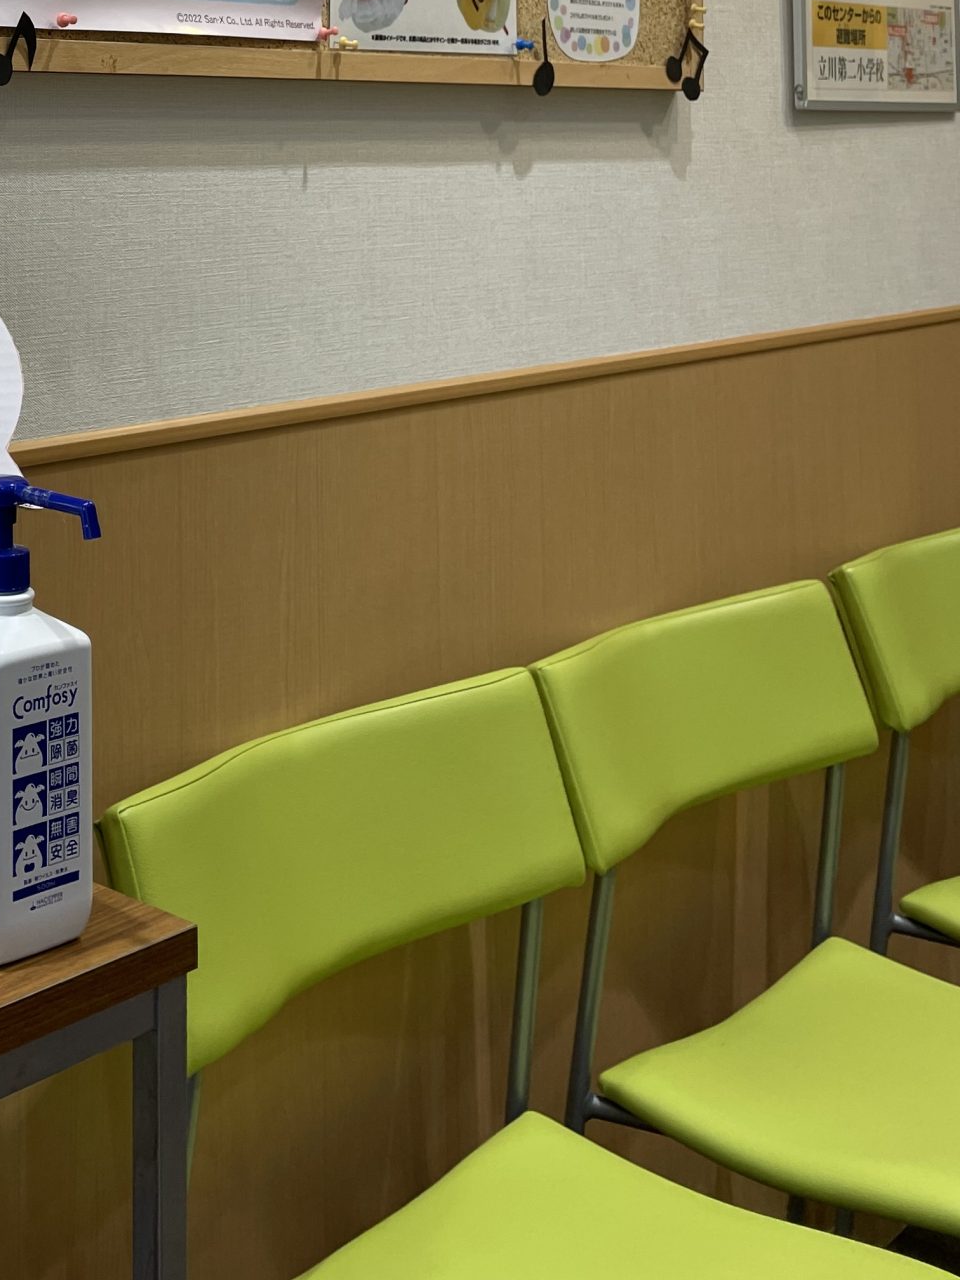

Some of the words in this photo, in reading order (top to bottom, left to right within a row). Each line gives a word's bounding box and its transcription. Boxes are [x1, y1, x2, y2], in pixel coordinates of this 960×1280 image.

[255, 17, 263, 27] All
[263, 18, 284, 29] Rights
[817, 4, 881, 24] このセンターからの
[817, 55, 884, 82] 立川第二小学校
[12, 684, 78, 720] Comfosy
